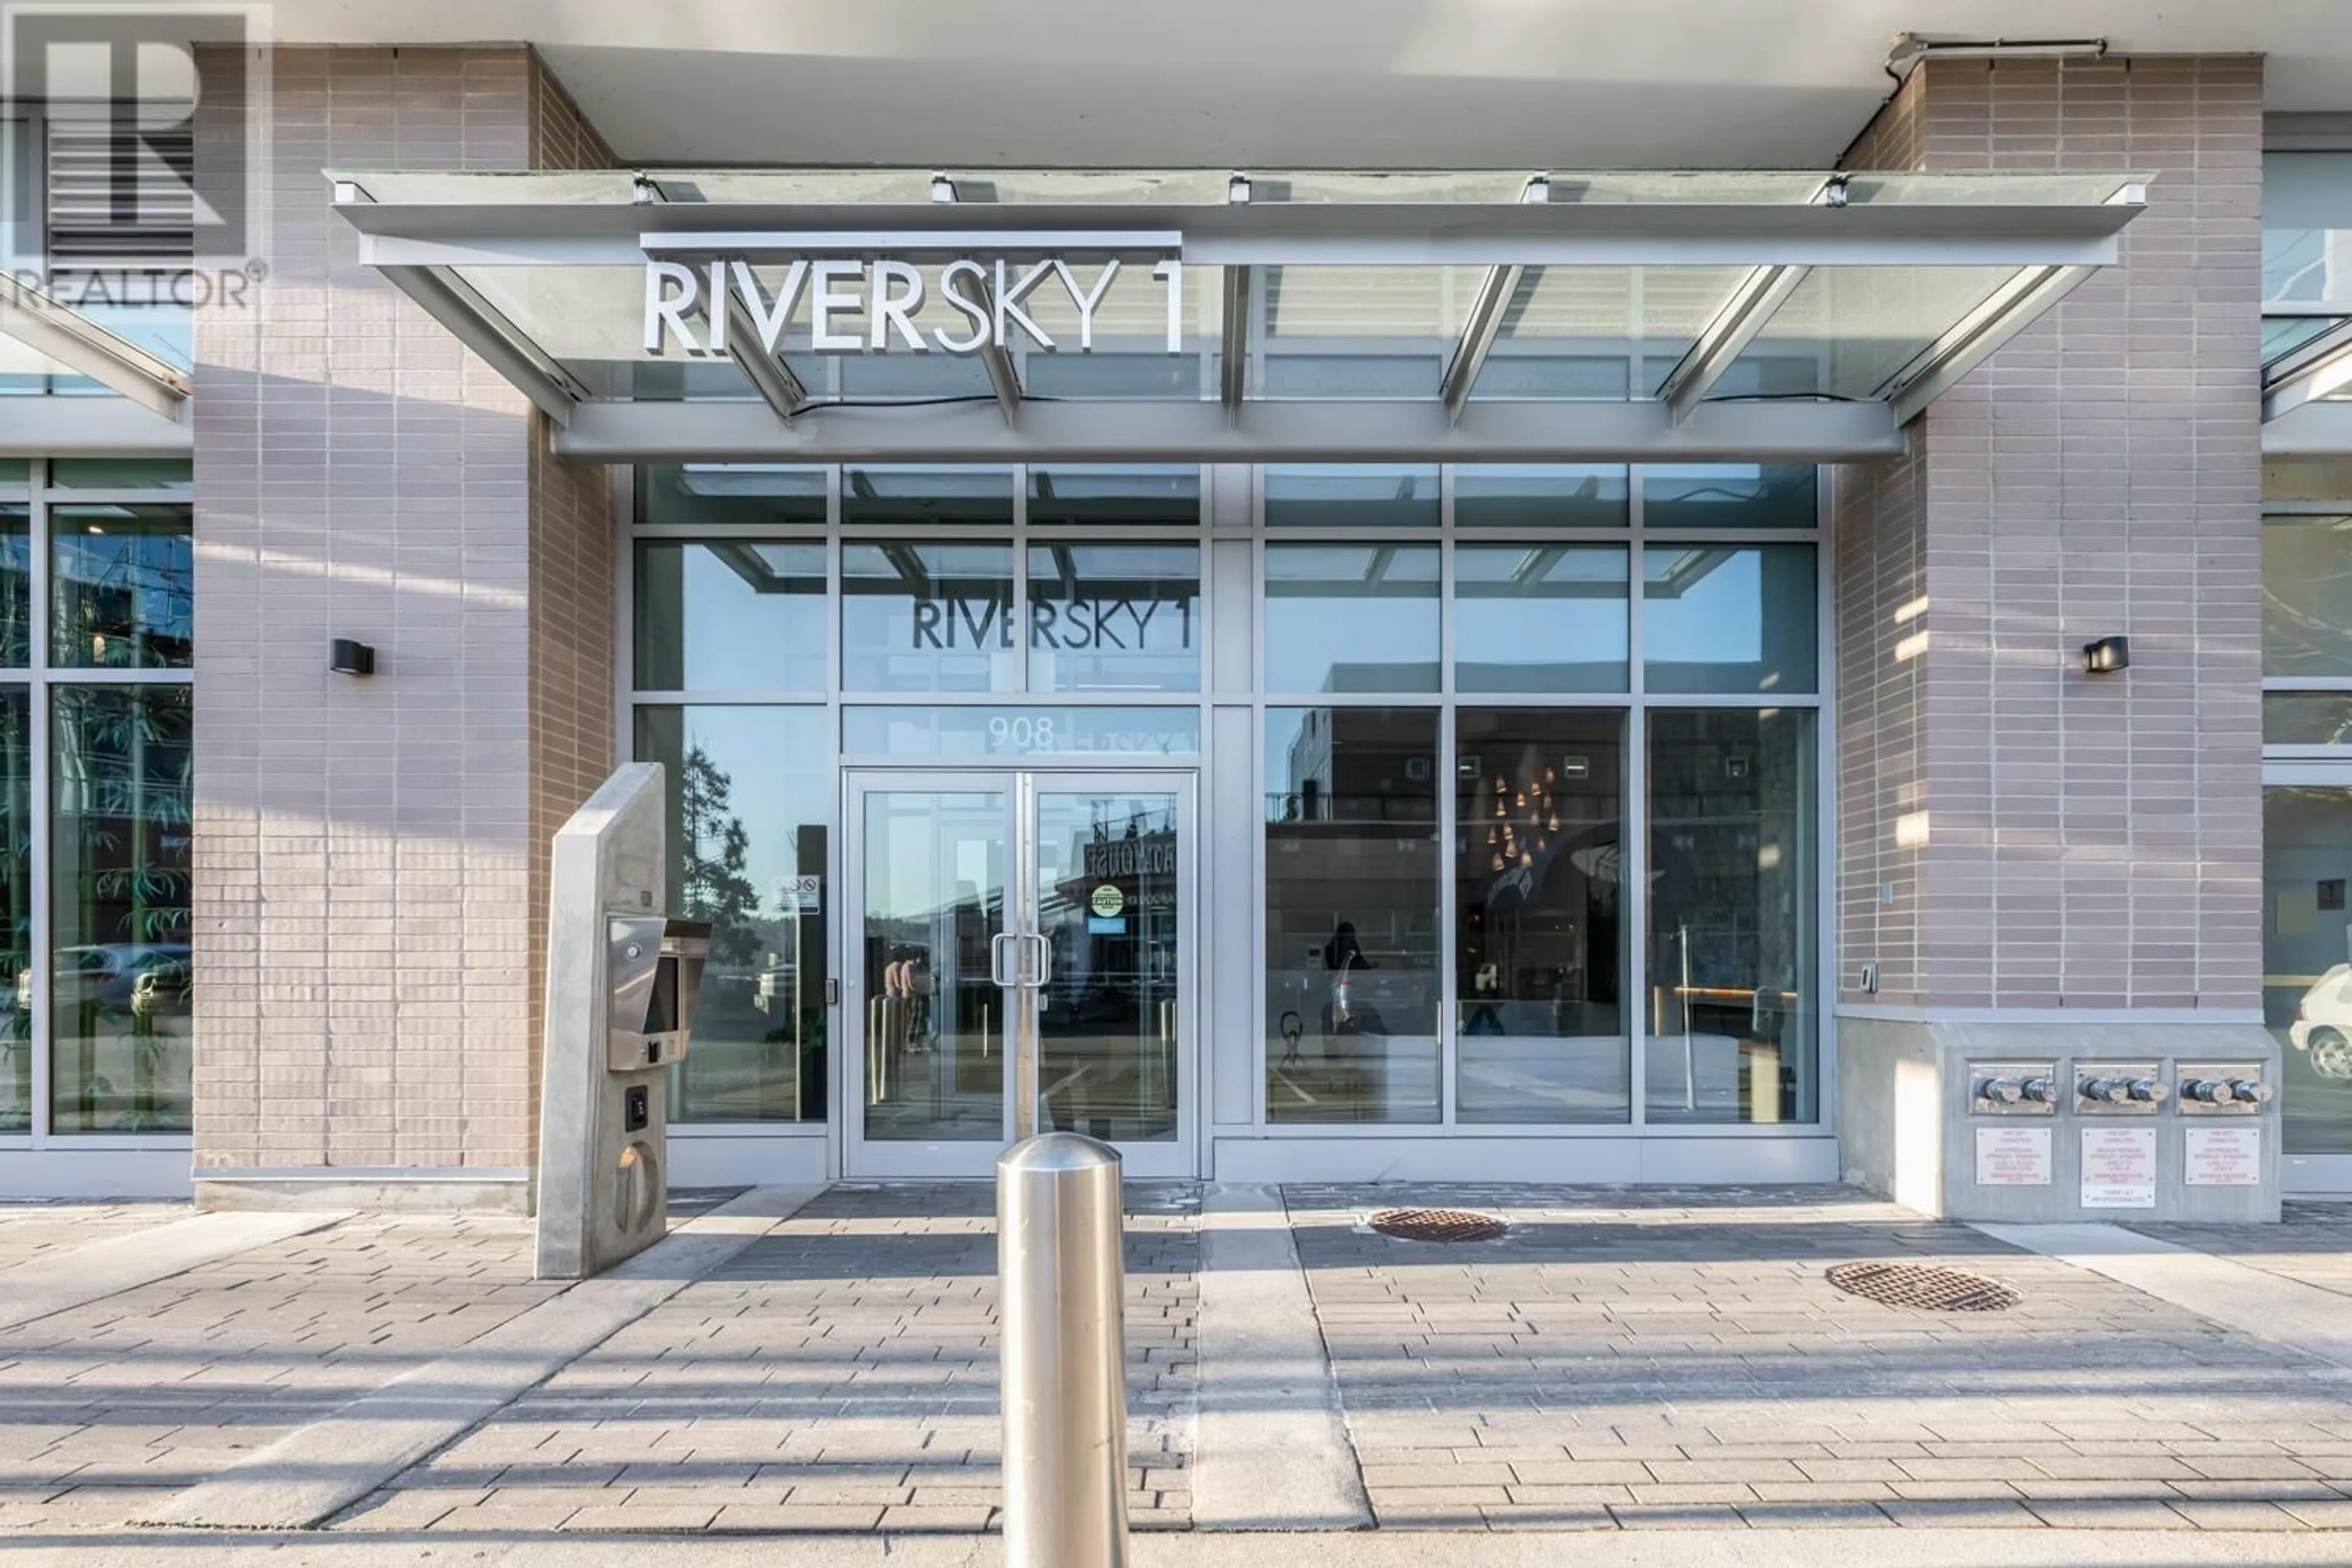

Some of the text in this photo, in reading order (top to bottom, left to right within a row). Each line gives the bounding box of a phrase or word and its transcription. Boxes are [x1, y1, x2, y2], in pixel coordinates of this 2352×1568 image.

[644, 259, 1183, 357] RIVERSKY 1
[913, 598, 1159, 650] RIVERSKY
[989, 716, 1054, 747] 908
